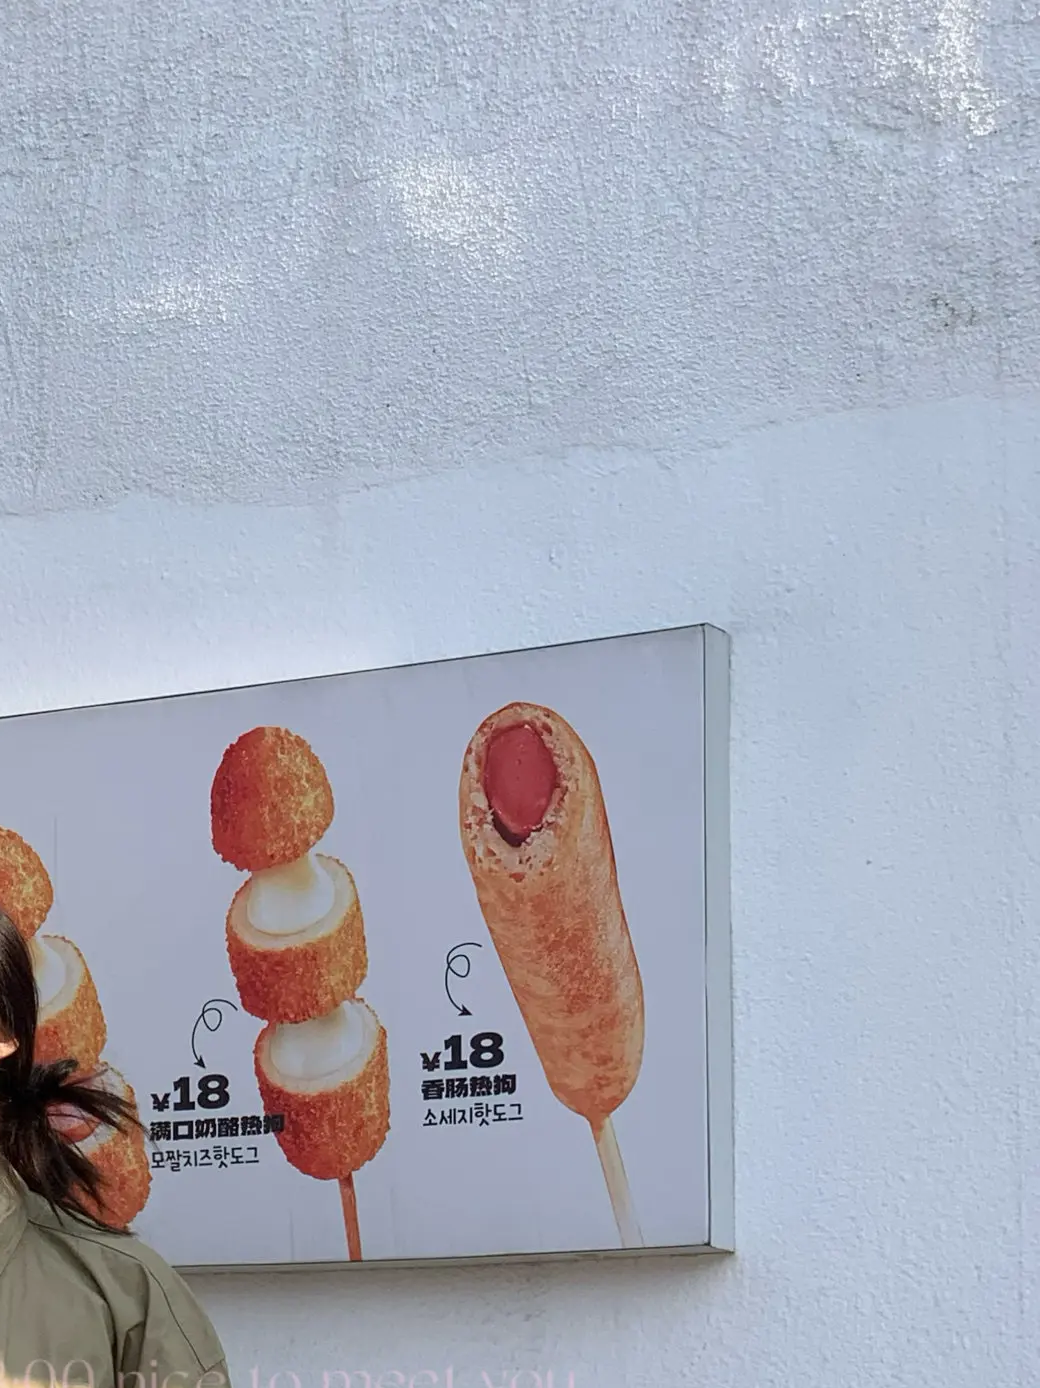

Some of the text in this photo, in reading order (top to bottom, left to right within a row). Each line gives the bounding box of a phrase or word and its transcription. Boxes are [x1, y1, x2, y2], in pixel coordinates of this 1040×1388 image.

[420, 1031, 505, 1072] ¥18
[150, 1073, 231, 1112] ¥18
[421, 1073, 517, 1101] 香肠热狗
[422, 1102, 524, 1127] 소세지핫도그
